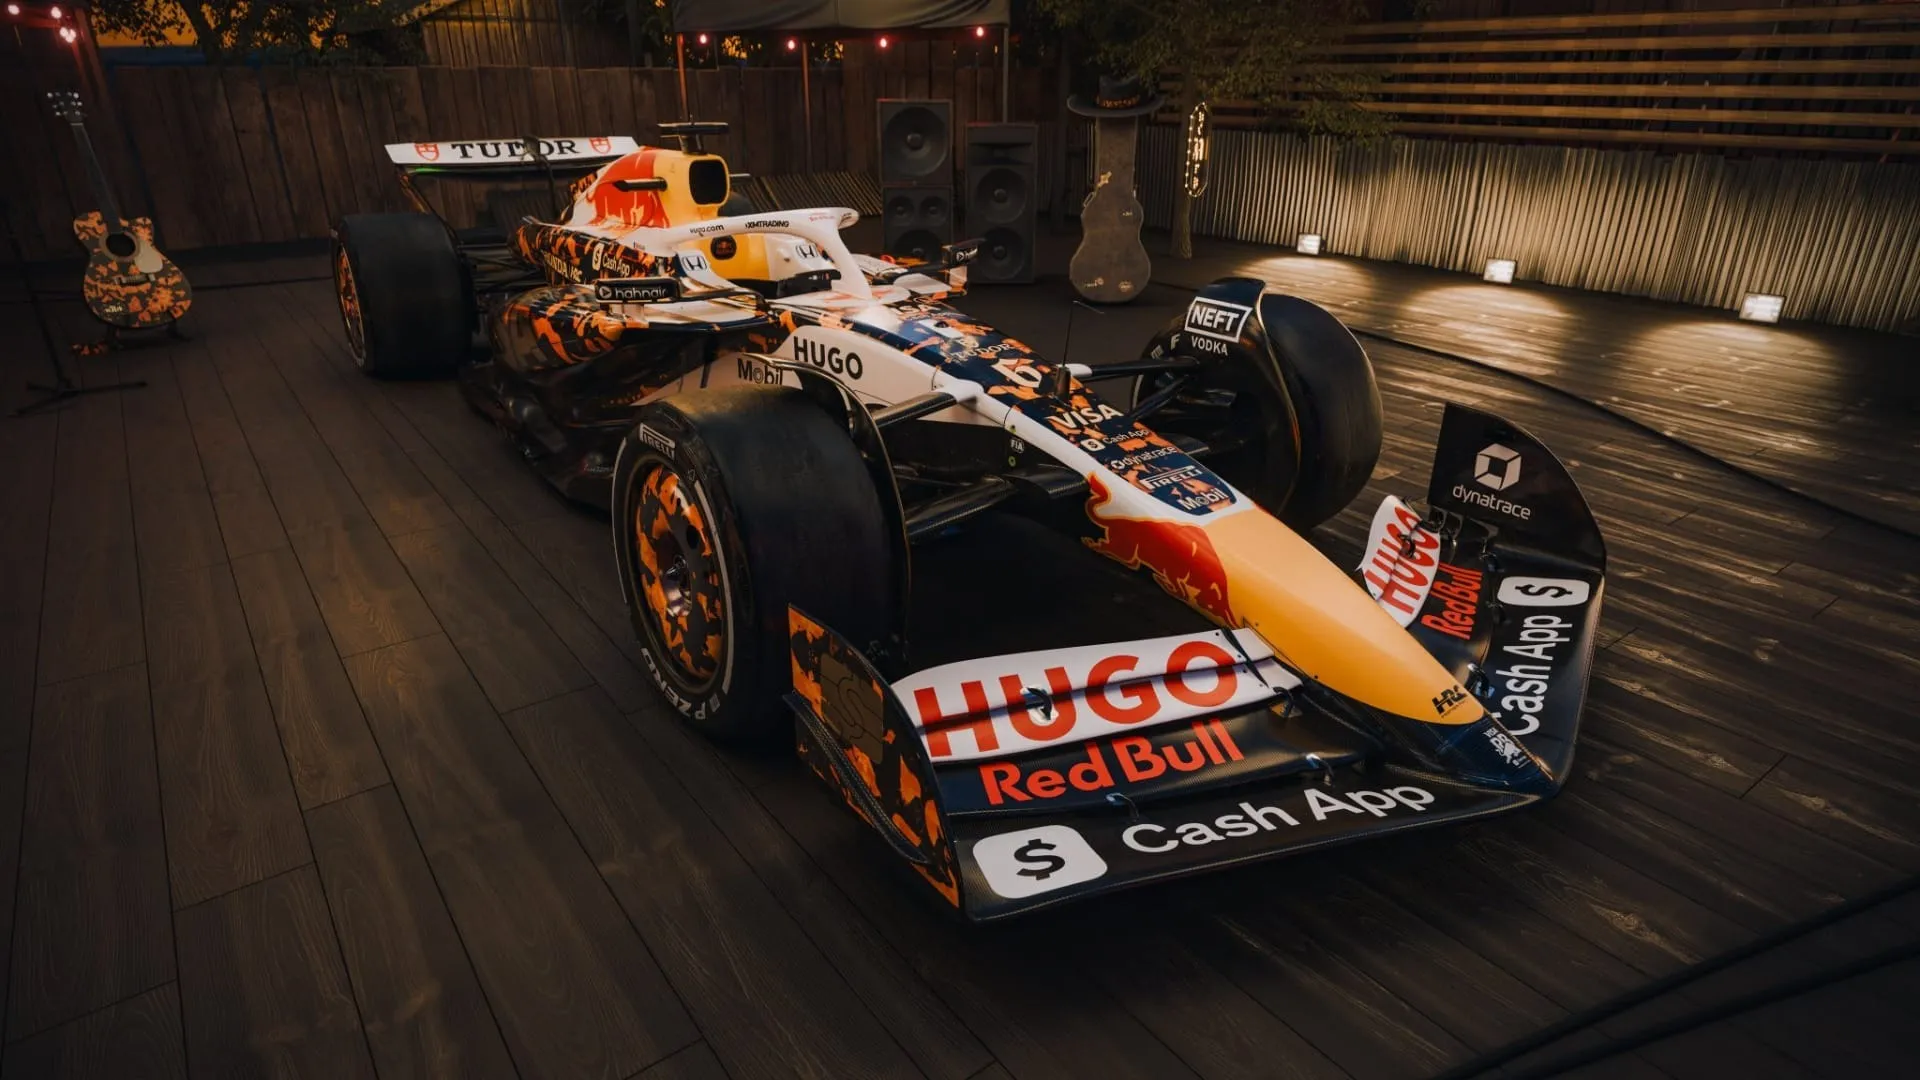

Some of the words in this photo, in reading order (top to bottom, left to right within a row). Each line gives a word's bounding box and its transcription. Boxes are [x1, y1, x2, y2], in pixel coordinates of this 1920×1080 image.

[602, 252, 617, 271] Cash
[617, 259, 631, 278] App
[615, 285, 667, 299] hahnair
[1191, 305, 1240, 331] NEFT
[793, 336, 863, 380] HUGO
[1191, 335, 1229, 356] VODKA
[737, 358, 783, 386] Mobil
[1045, 403, 1124, 428] VISA
[639, 422, 676, 461] PIRELLI
[1102, 432, 1129, 445] Cash
[1128, 428, 1150, 442] App
[1121, 445, 1177, 466] dynatrace
[1139, 465, 1203, 490] PIRELLI
[1177, 488, 1229, 511] Mobil
[1452, 484, 1532, 520] dynatrace
[1364, 506, 1438, 615] HUGO
[1502, 615, 1573, 660] App
[913, 641, 1239, 757] HUGO
[1491, 664, 1551, 736] Cash
[1121, 800, 1301, 853] Cash
[1303, 785, 1436, 821] App
